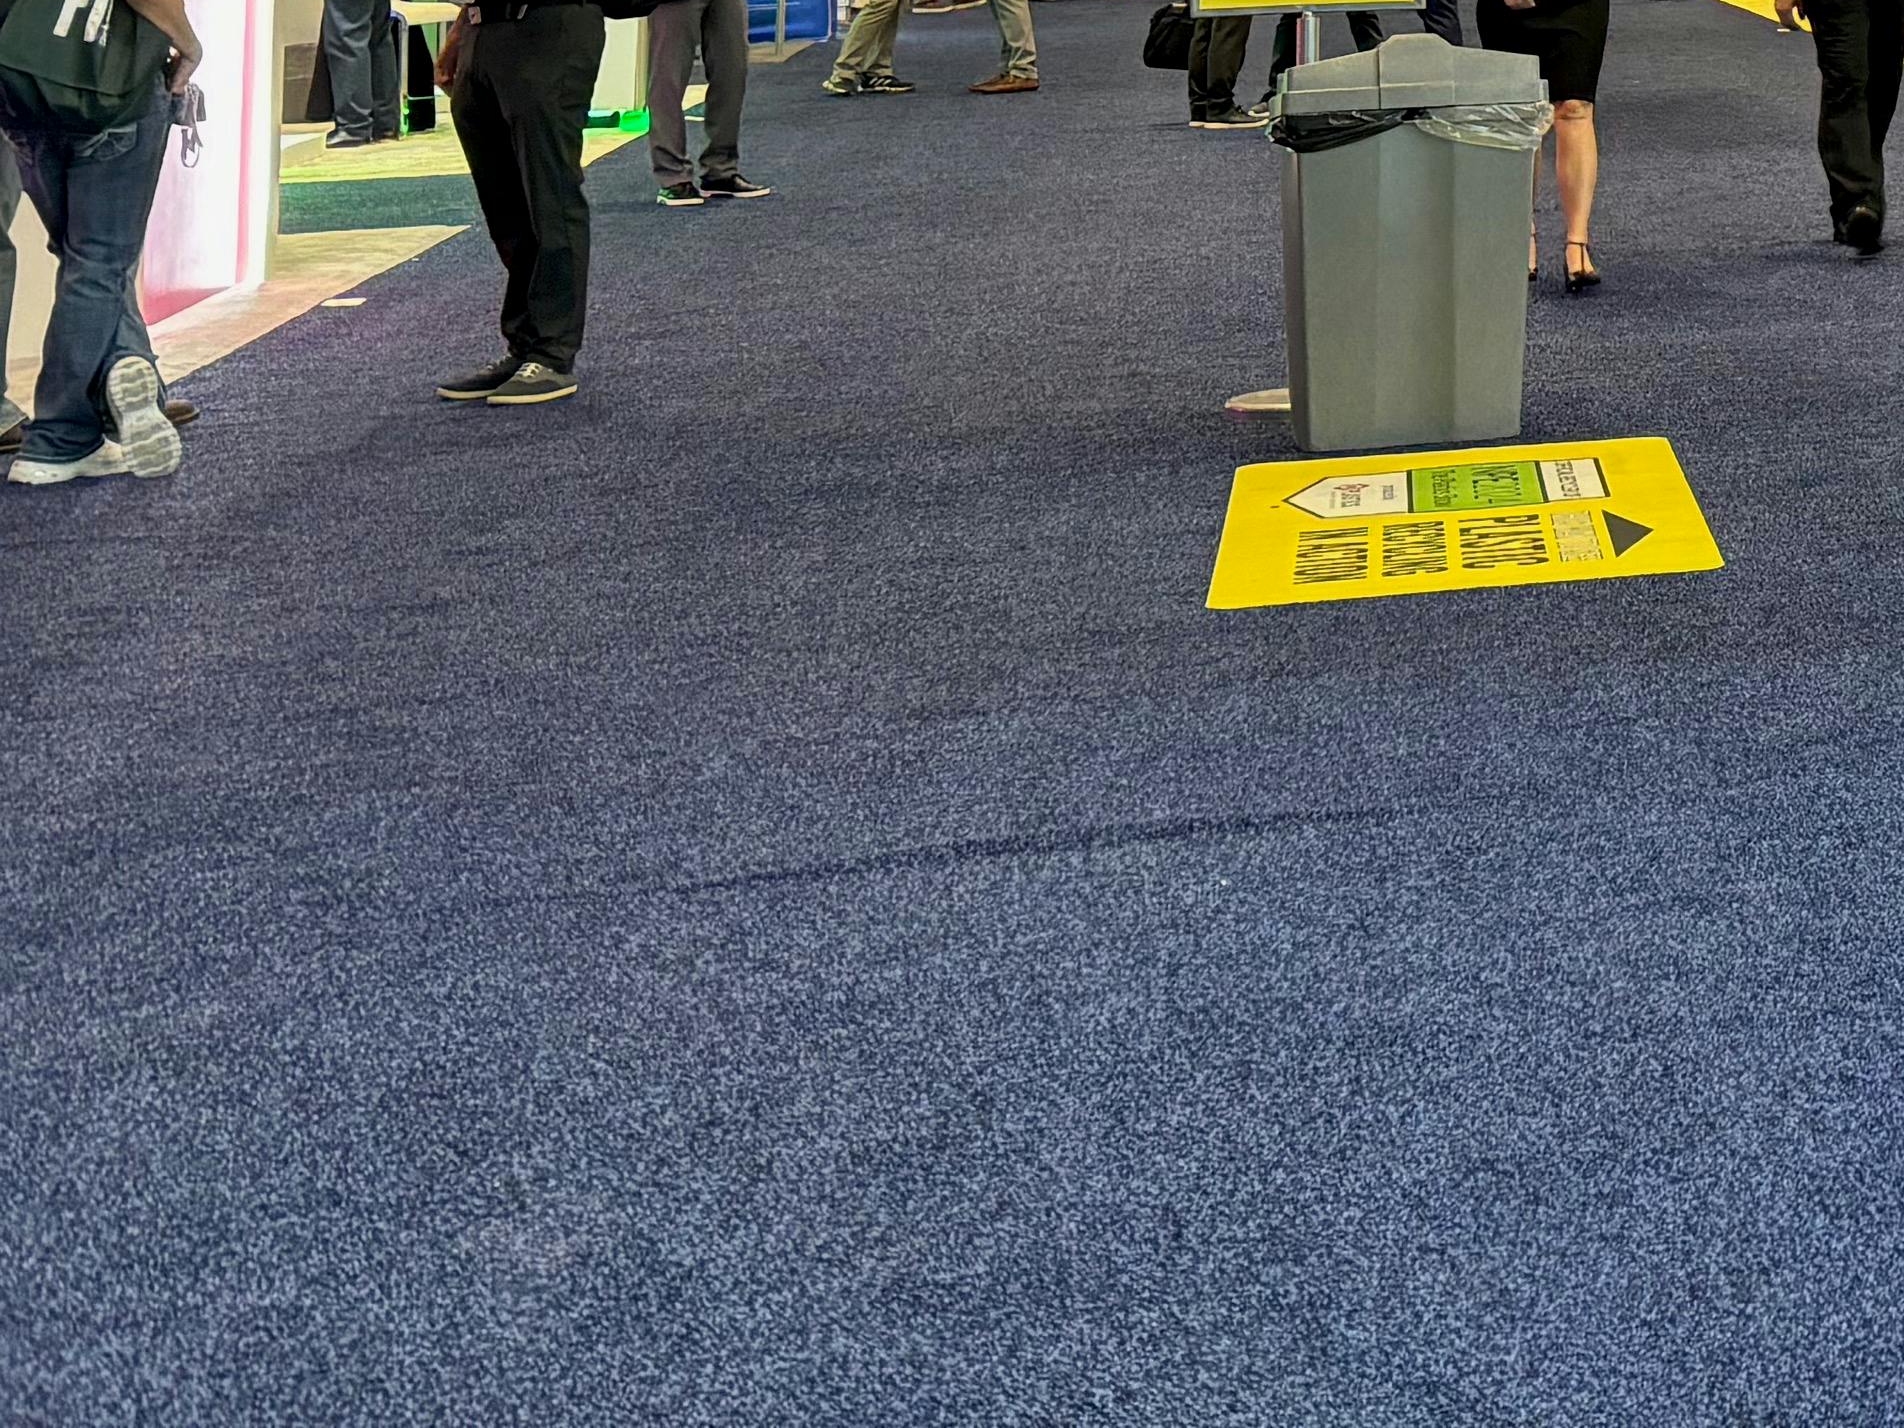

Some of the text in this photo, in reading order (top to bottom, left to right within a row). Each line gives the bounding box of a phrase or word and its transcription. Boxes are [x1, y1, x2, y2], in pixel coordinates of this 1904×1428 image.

[1292, 526, 1368, 584] IN ACTION
[1381, 520, 1448, 577] RECYCLING
[1456, 513, 1549, 570] PLASTIC
